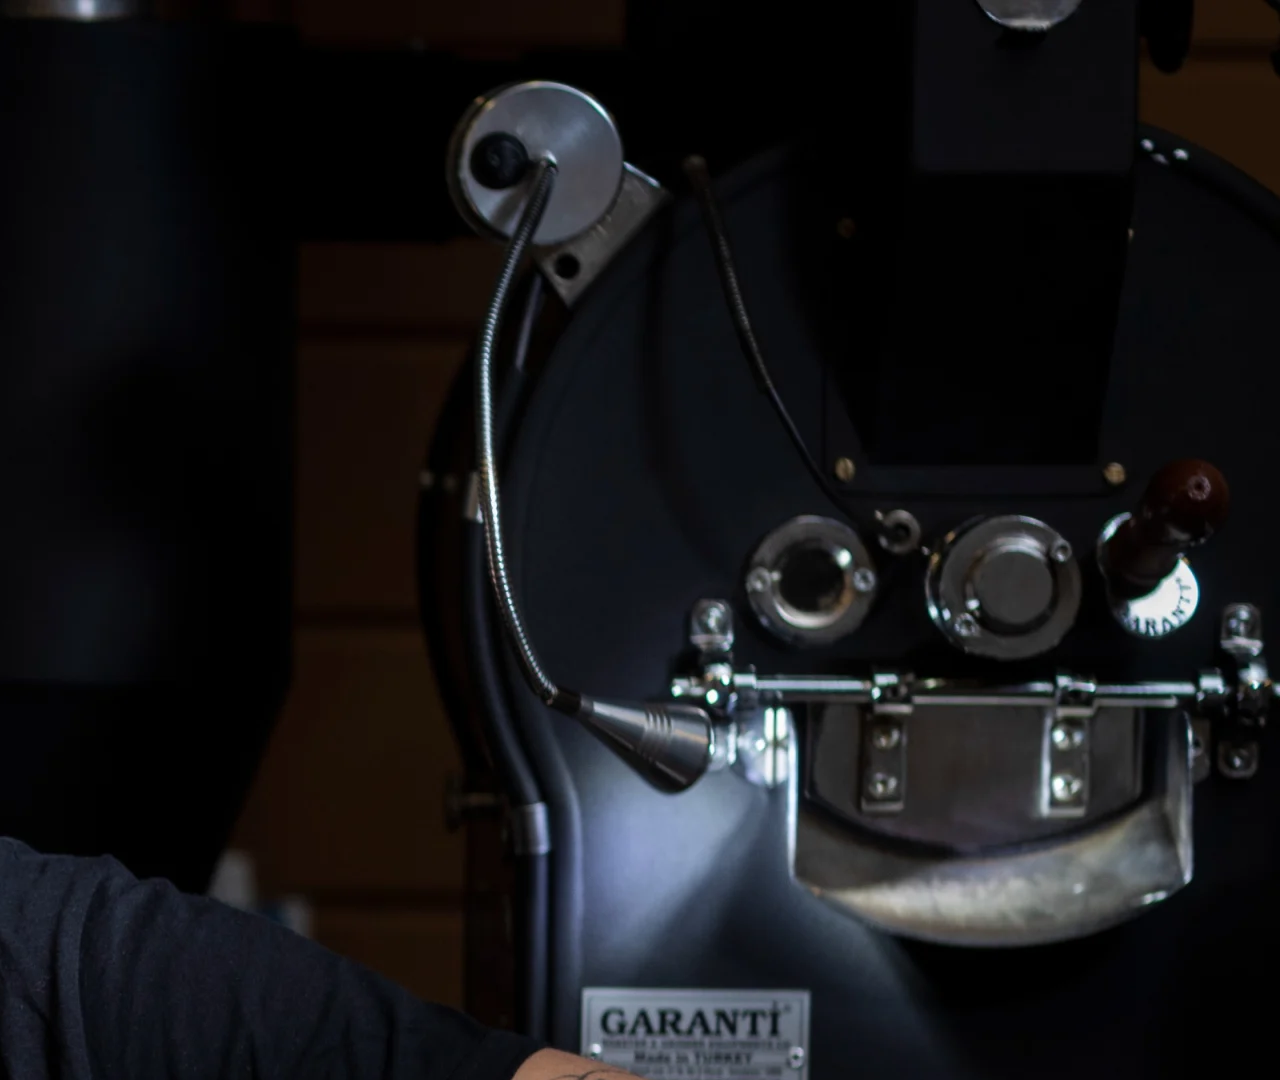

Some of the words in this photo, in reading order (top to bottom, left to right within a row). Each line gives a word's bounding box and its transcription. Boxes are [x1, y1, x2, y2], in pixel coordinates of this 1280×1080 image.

[633, 1051, 671, 1064] Made
[675, 1052, 690, 1064] in
[694, 1052, 754, 1065] TURKEY
